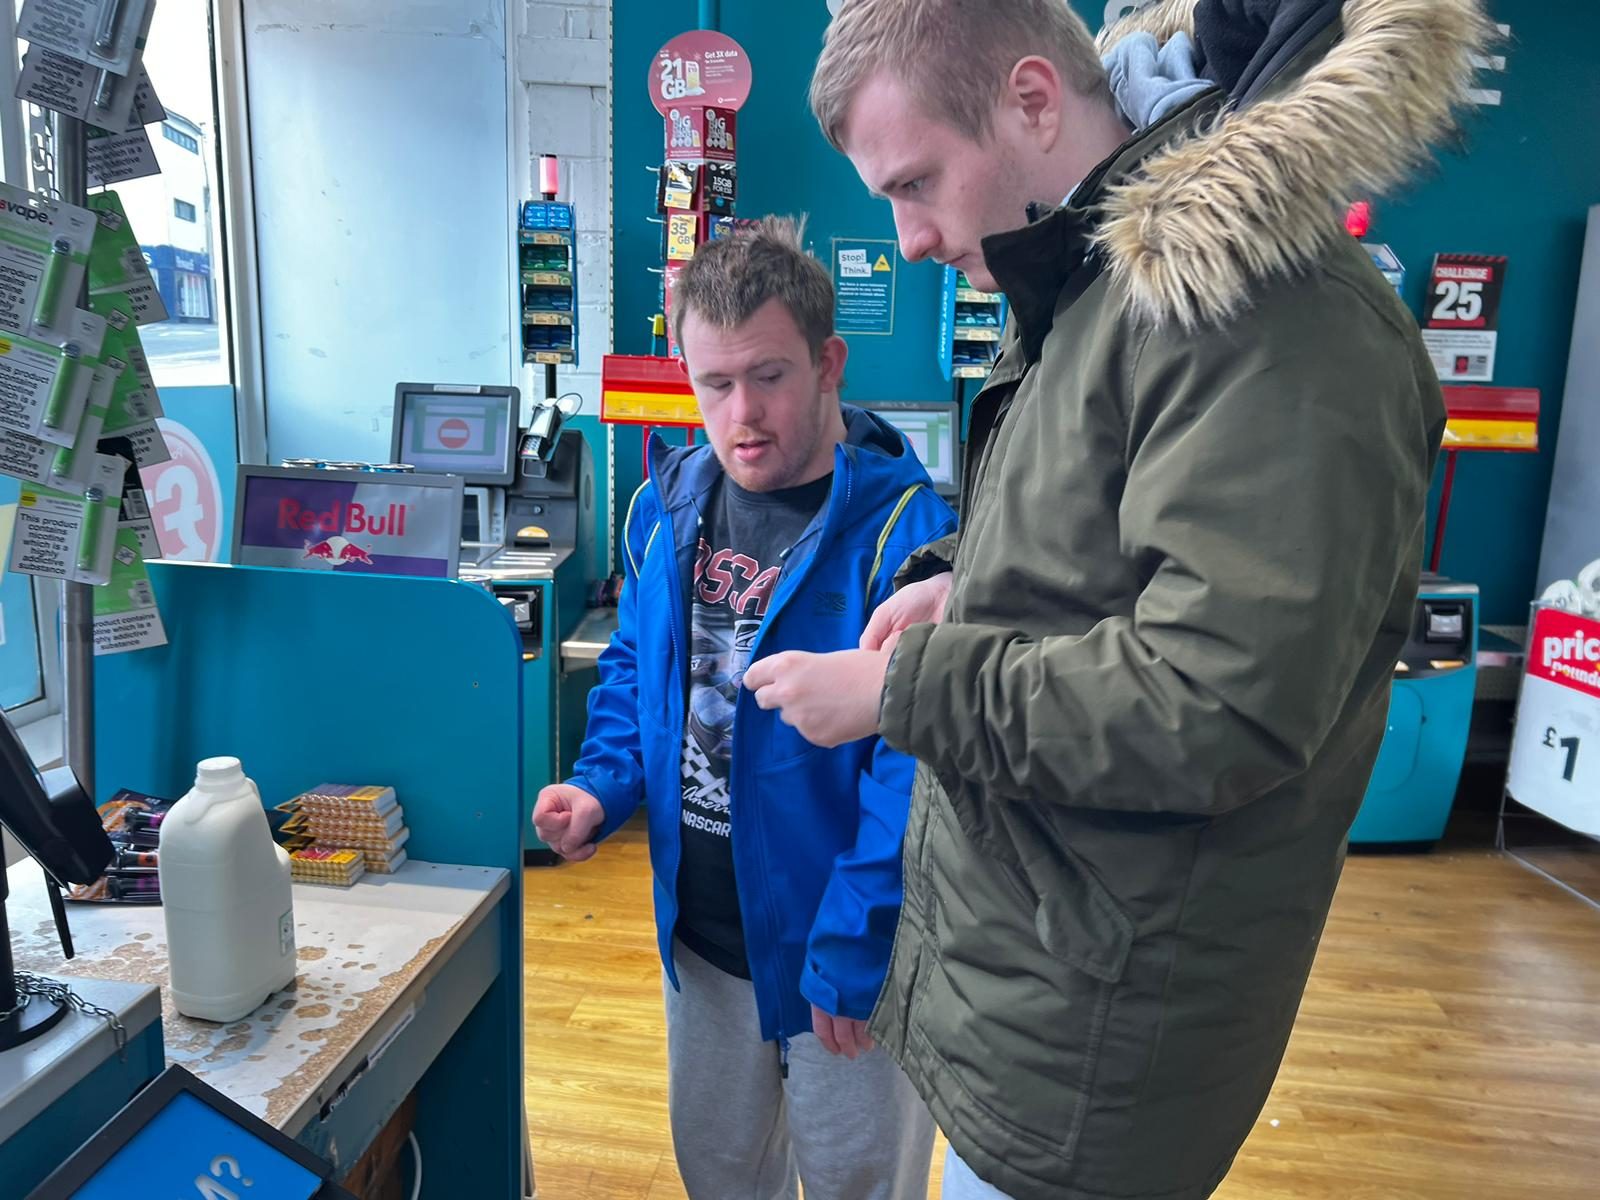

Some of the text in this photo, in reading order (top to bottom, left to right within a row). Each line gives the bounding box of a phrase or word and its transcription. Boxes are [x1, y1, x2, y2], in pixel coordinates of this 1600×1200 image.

[660, 57, 682, 81] 21
[661, 79, 686, 100] GB
[670, 222, 688, 235] 35
[677, 235, 691, 245] GB
[841, 253, 865, 262] Stop!
[843, 266, 869, 275] Think.
[1435, 267, 1488, 280] CHALLENGE
[1432, 280, 1484, 321] 25
[14, 368, 49, 384] product
[20, 513, 78, 529] This product
[277, 498, 407, 536] Red Bull
[28, 524, 68, 535] contains
[29, 532, 65, 542] nicotine
[23, 539, 50, 549] which
[31, 547, 58, 560] highly
[22, 555, 65, 567] addictive
[18, 563, 66, 575] substance
[694, 537, 781, 615] SCA
[121, 613, 155, 624] contains
[112, 624, 136, 632] which
[113, 630, 148, 640] addictive
[101, 640, 140, 650] substance
[1543, 630, 1600, 667] pric
[1542, 725, 1580, 783] £1
[681, 808, 732, 838] NASCAR
